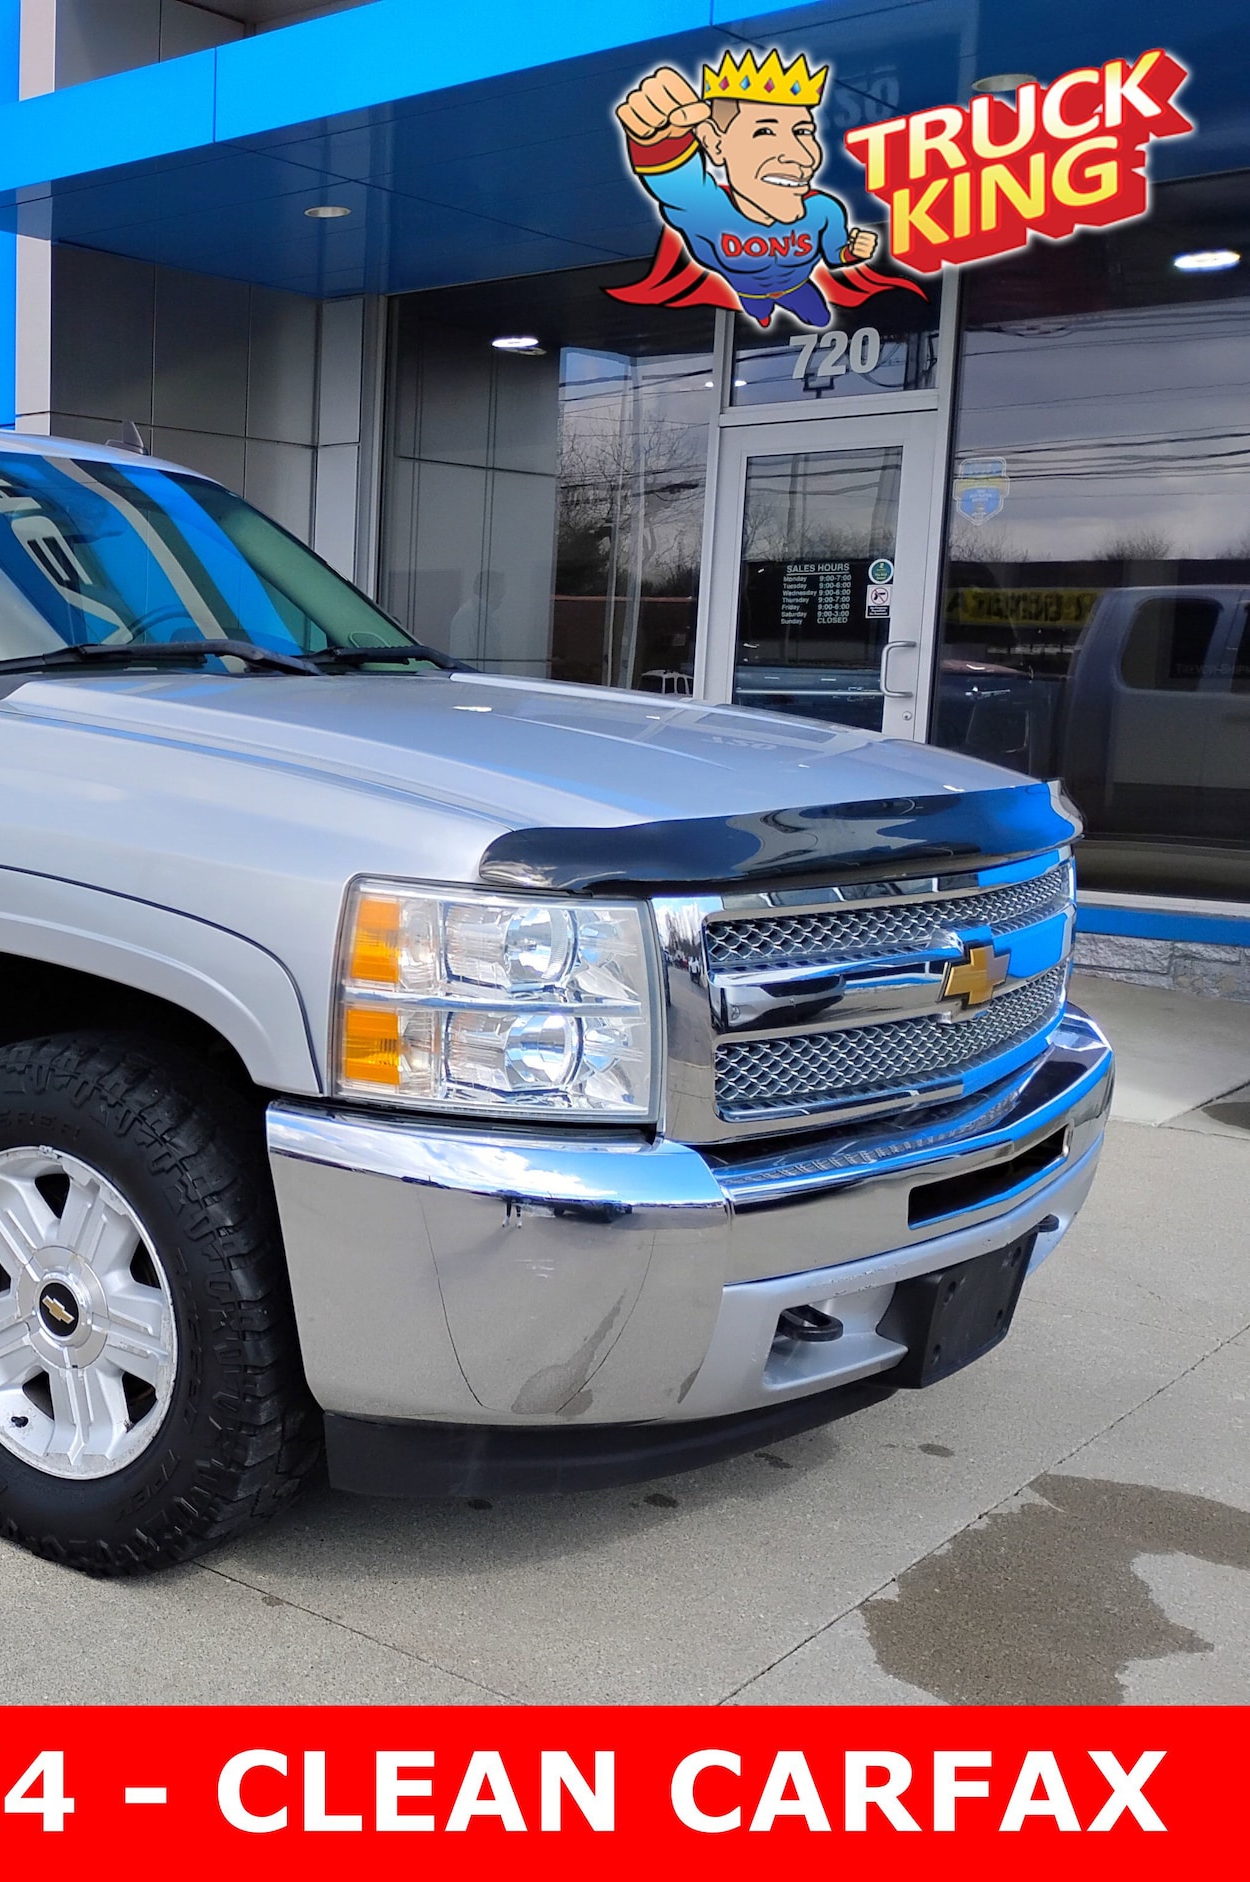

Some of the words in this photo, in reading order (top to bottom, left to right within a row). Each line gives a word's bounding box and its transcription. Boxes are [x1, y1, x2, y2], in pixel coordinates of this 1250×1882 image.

[789, 326, 880, 379] 720
[786, 563, 815, 573] SALES
[817, 563, 850, 572] HOURS
